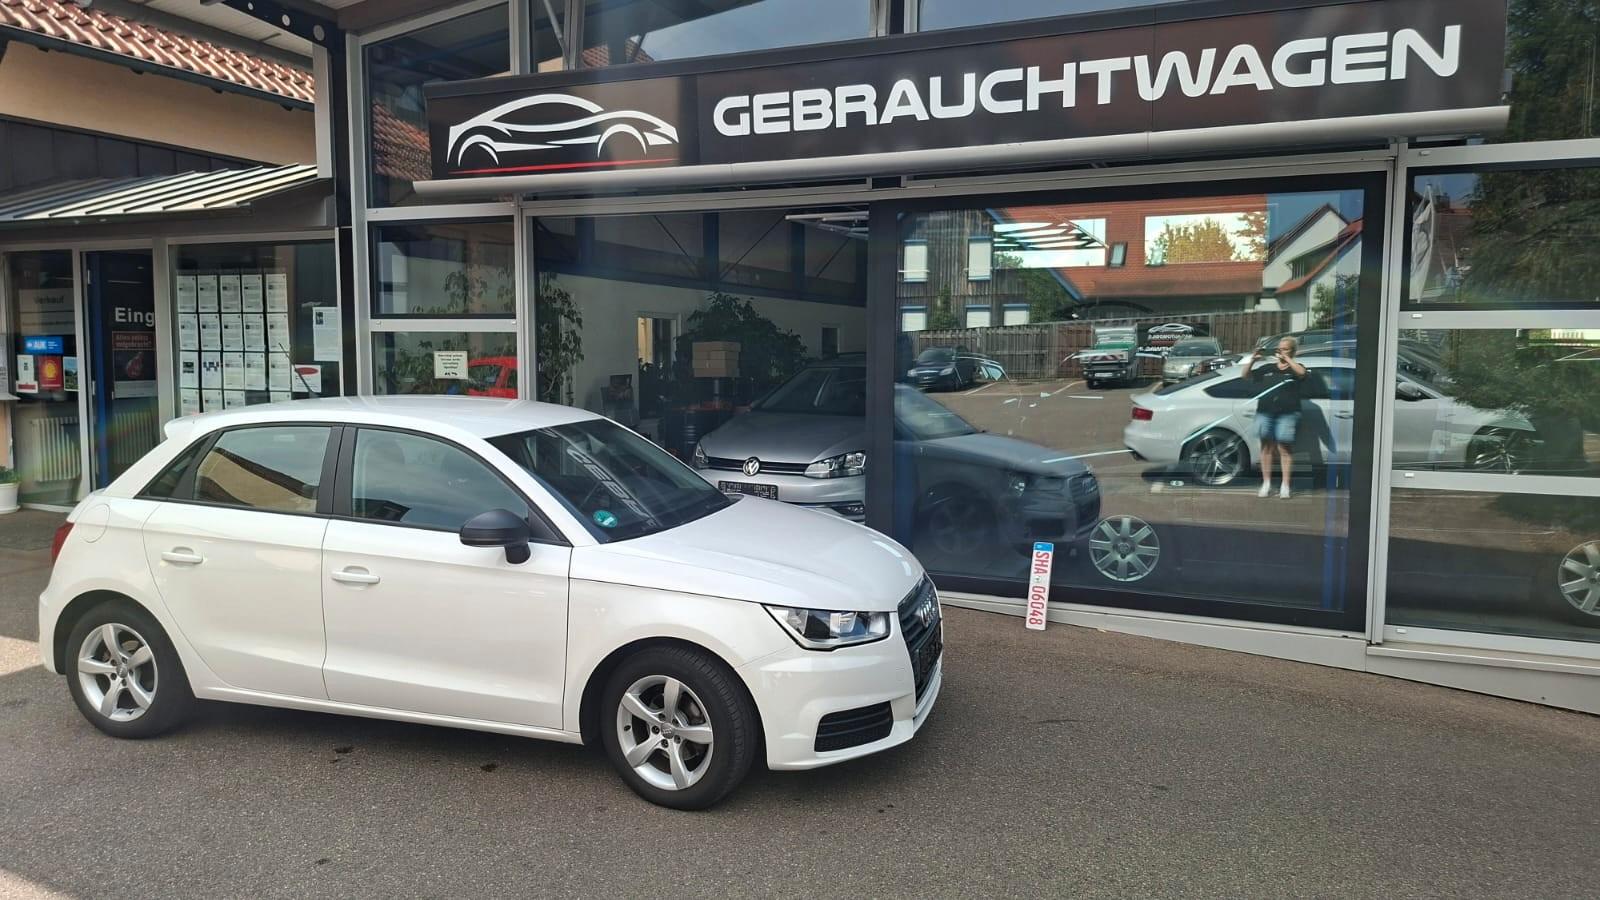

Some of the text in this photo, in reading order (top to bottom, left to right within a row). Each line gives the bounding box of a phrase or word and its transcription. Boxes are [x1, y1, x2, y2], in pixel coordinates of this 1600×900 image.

[712, 25, 1461, 136] GEBRAUCHTWAGEN
[115, 307, 154, 327] Eing
[1029, 552, 1050, 625] SHA 06048
